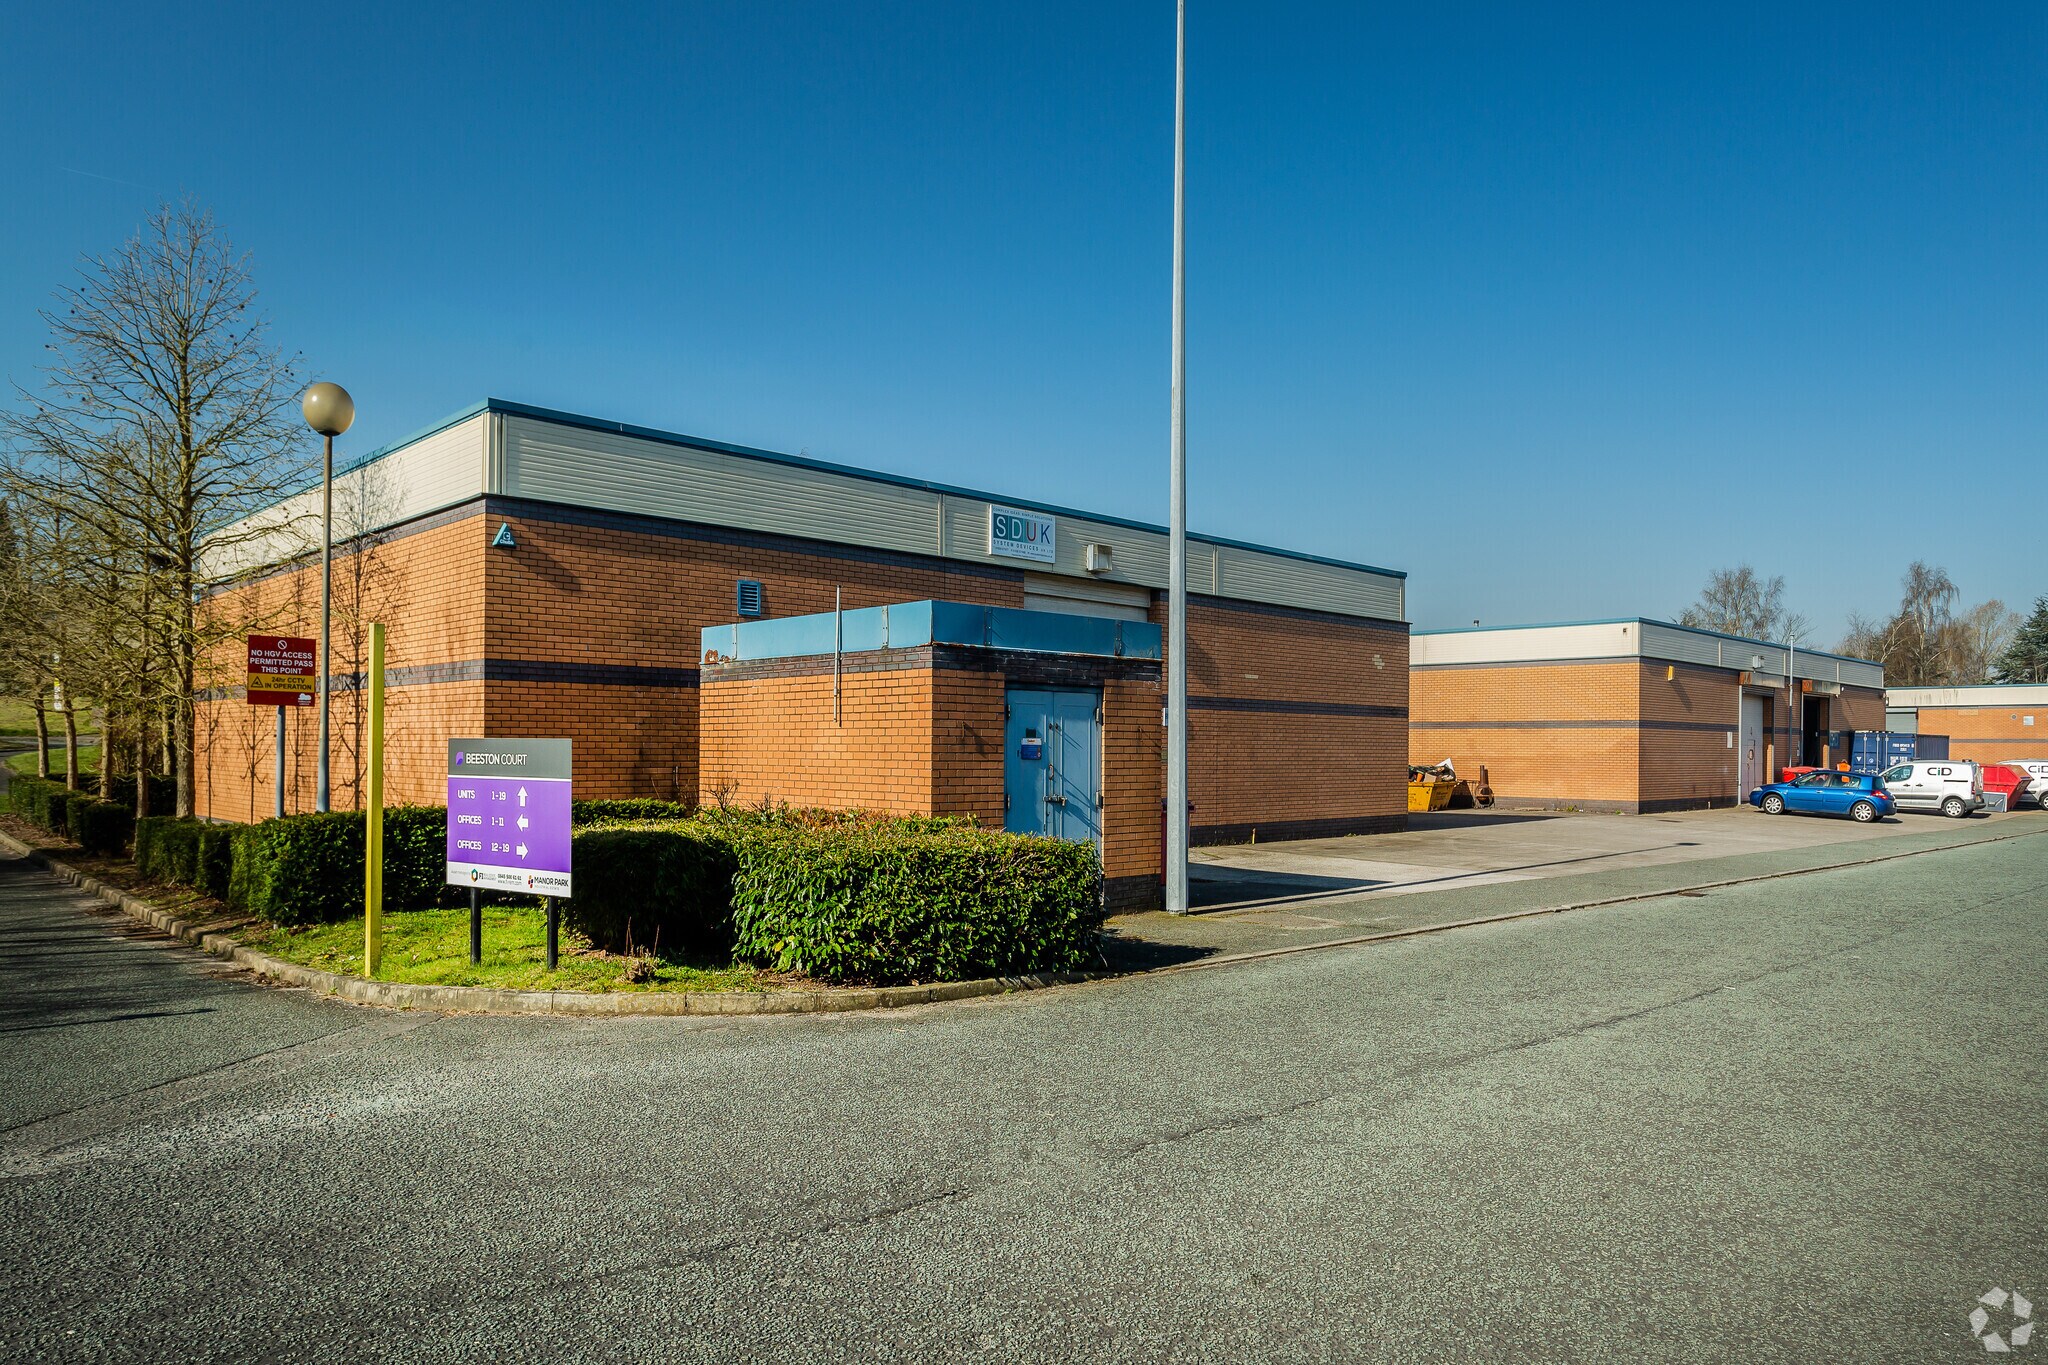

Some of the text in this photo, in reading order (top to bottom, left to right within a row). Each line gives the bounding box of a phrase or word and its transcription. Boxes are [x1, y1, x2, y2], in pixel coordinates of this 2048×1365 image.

[1017, 543, 1039, 551] DEVICES
[466, 753, 527, 765] BEESTON COURT
[1927, 767, 1952, 776] CiD
[458, 790, 475, 799] UNITS
[458, 815, 482, 825] OFFICES
[457, 840, 482, 850] OFFICES
[534, 876, 569, 887] MANOR PARK
